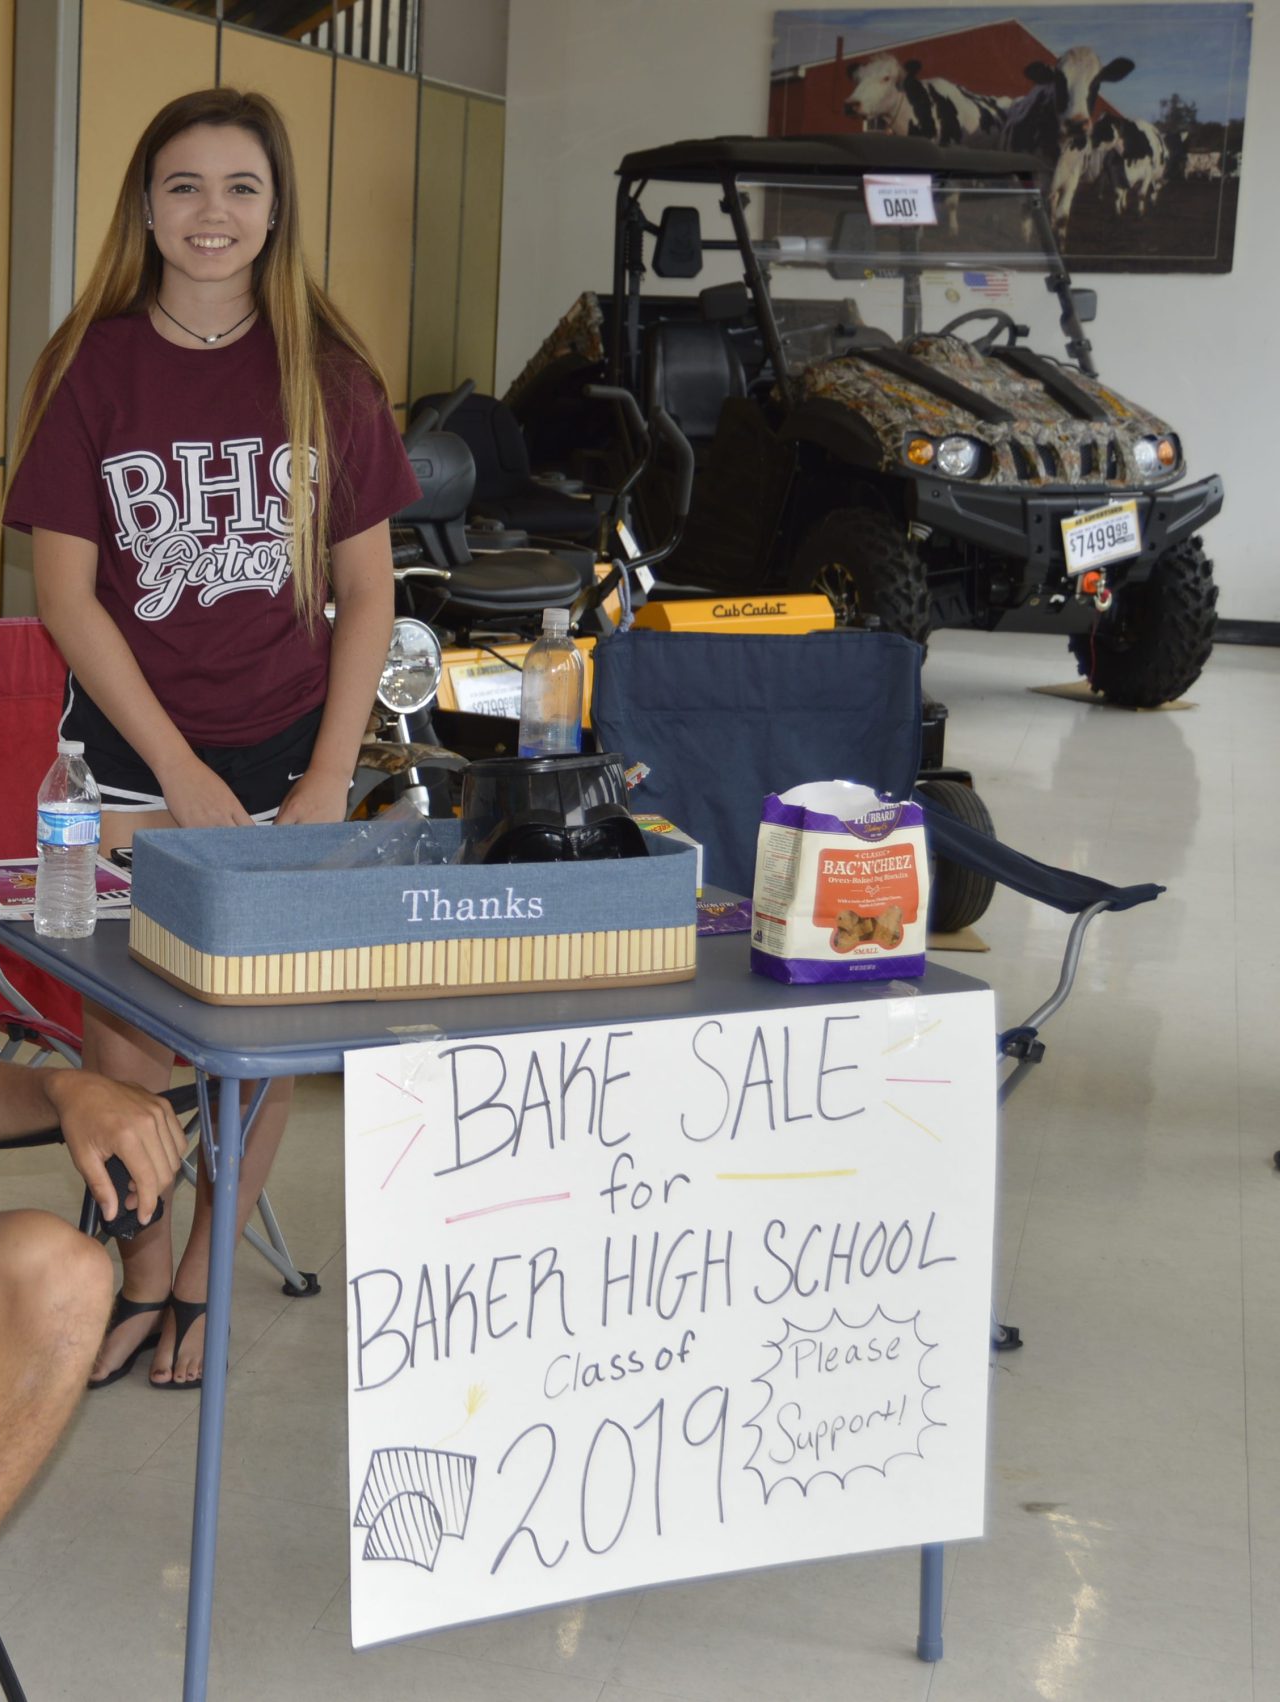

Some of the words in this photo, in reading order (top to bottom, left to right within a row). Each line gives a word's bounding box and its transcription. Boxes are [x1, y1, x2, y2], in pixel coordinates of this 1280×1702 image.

[883, 198, 918, 217] DAD!
[101, 437, 321, 551] BHS
[712, 603, 740, 618] Cub
[741, 601, 788, 617] Cadet
[402, 887, 544, 922] Thanks
[433, 1031, 634, 1176] BAKE
[680, 1015, 866, 1142] SALE
[599, 1152, 692, 1214] for
[349, 1246, 576, 1391] BAKER
[601, 1228, 734, 1327] HIGH
[753, 1211, 958, 1304] SCHOOL
[543, 1352, 652, 1400] Class
[654, 1330, 697, 1372] of
[790, 1337, 901, 1380] Please
[767, 1394, 909, 1464] Support!
[490, 1385, 731, 1575] 2019
